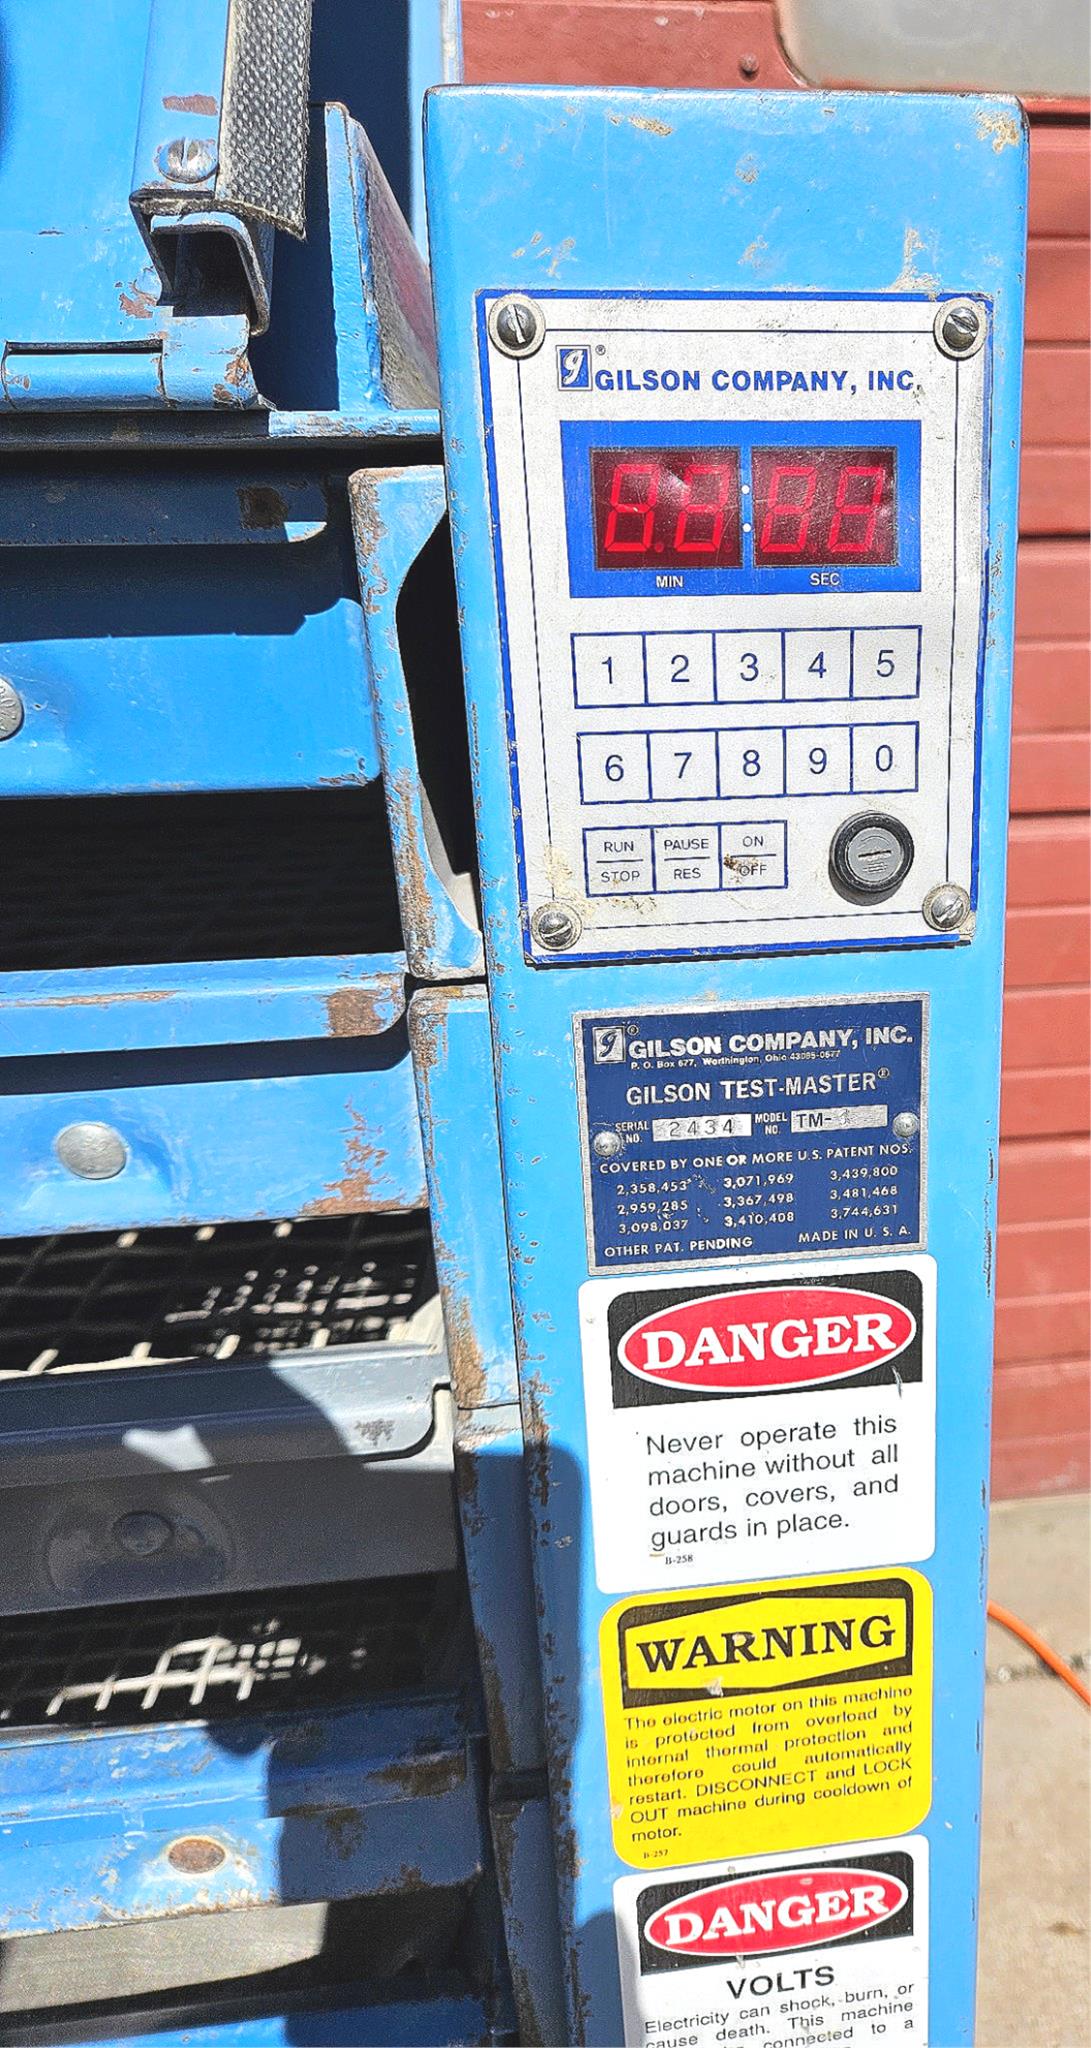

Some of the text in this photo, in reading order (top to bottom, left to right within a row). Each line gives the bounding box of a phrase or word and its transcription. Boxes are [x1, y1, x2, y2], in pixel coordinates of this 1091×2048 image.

[595, 370, 700, 391] GILSON
[712, 369, 857, 395] COMPANY,
[868, 369, 921, 391] INC.
[656, 572, 840, 588] MIN SEC
[602, 649, 896, 684] 1 2 3 4 5
[605, 744, 894, 781] 6 7 8 9 0
[604, 841, 635, 853] RUN
[664, 838, 709, 850] PAUSE
[742, 836, 764, 847] ON
[601, 870, 640, 883] STOP
[673, 868, 701, 880] RES
[739, 864, 767, 876] OFF
[628, 1036, 722, 1060] GILSON
[728, 1028, 858, 1053] COMPANY,
[865, 1025, 914, 1045] INC.
[657, 1060, 676, 1069] Box
[703, 1054, 762, 1066] Worthington,
[765, 1053, 787, 1062] Ohio
[626, 1082, 711, 1106] GILSON
[615, 1120, 649, 1132] SERIAL
[669, 1119, 733, 1137] 2434
[755, 1112, 787, 1124] MODEL
[764, 1124, 781, 1135] NO.
[626, 1133, 643, 1144] NO.
[600, 1143, 913, 1174] COVERED BY ONE OR MORE U.S. PATENT NOS.
[616, 1166, 898, 1196] 2,358,453 3,071,969 3,439,800
[616, 1185, 898, 1216] 2,959,285 3,367,498 3,481,468
[618, 1204, 898, 1235] 3,098,037 3,410,408 3,744,631
[604, 1236, 753, 1258] OTHER PAT. PENDING
[798, 1230, 838, 1243] MADE
[844, 1228, 858, 1240] IN
[642, 1313, 897, 1370] DANGER
[646, 1414, 897, 1455] Never operate this
[648, 1443, 898, 1486] machine without all
[650, 1473, 899, 1517] doors, covers, and
[651, 1513, 850, 1552] guards in place.
[665, 1554, 693, 1566] B-258
[636, 1614, 896, 1673] WARNING
[625, 1687, 912, 1730] The electric motor on this machine
[625, 1704, 912, 1749] is protected from overload by
[627, 1721, 912, 1768] internal thermal protection and
[628, 1741, 912, 1787] therefore could automatically
[630, 1757, 912, 1805] restart. DISCONNECT and LOCK
[630, 1776, 912, 1824] OUT machine during cooldown of
[632, 1826, 682, 1842] motor.
[665, 1885, 889, 1945] DANGER
[726, 1966, 835, 1999] VOLTS
[645, 1983, 914, 2034] Electricity can shock, burn, or
[645, 2002, 913, 2048] cause death. This machine
[763, 2019, 914, 2048] connected to a
